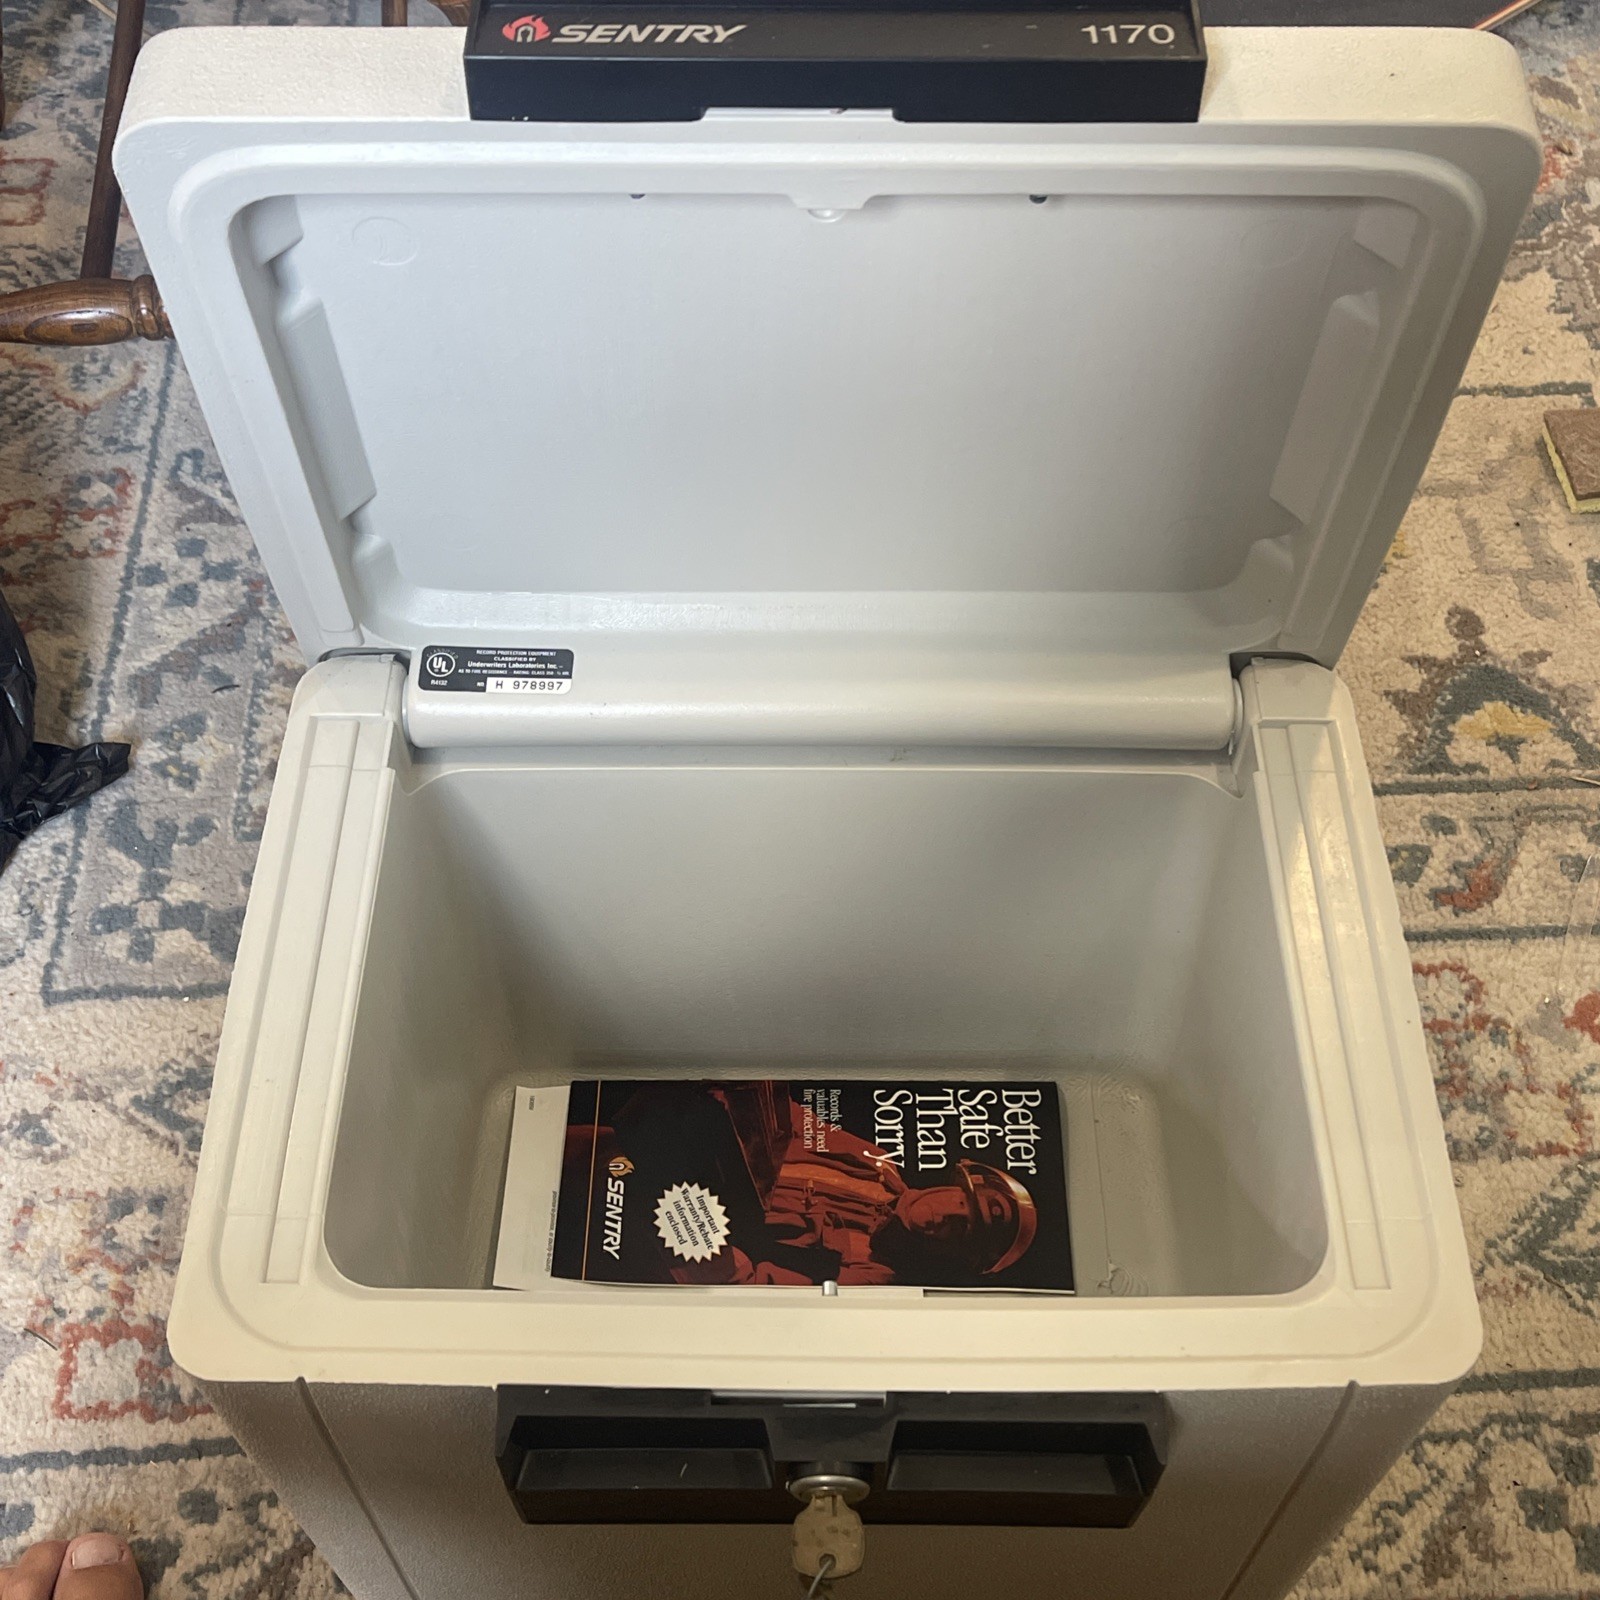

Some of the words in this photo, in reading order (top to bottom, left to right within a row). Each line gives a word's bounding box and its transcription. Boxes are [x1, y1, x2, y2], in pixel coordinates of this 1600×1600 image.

[552, 24, 748, 44] SENTRY
[1081, 24, 1175, 44] 1170
[467, 661, 507, 669] Underwriters
[495, 681, 504, 690] H
[513, 681, 564, 691] 978997
[803, 1089, 816, 1103] fire
[816, 1089, 832, 1127] valuables
[830, 1089, 842, 1123] Records
[801, 1104, 815, 1149] protection
[830, 1124, 842, 1133] &
[863, 1089, 914, 1169] Sorry.
[915, 1088, 960, 1172] Than
[957, 1089, 1004, 1150] Safe
[1002, 1089, 1042, 1175] Better
[816, 1129, 829, 1153] need
[602, 1177, 625, 1260] SENTRY
[664, 1210, 688, 1246] enclosed
[672, 1200, 700, 1247] information
[681, 1187, 714, 1251] Warranty/Rebate
[696, 1195, 721, 1235] Important
